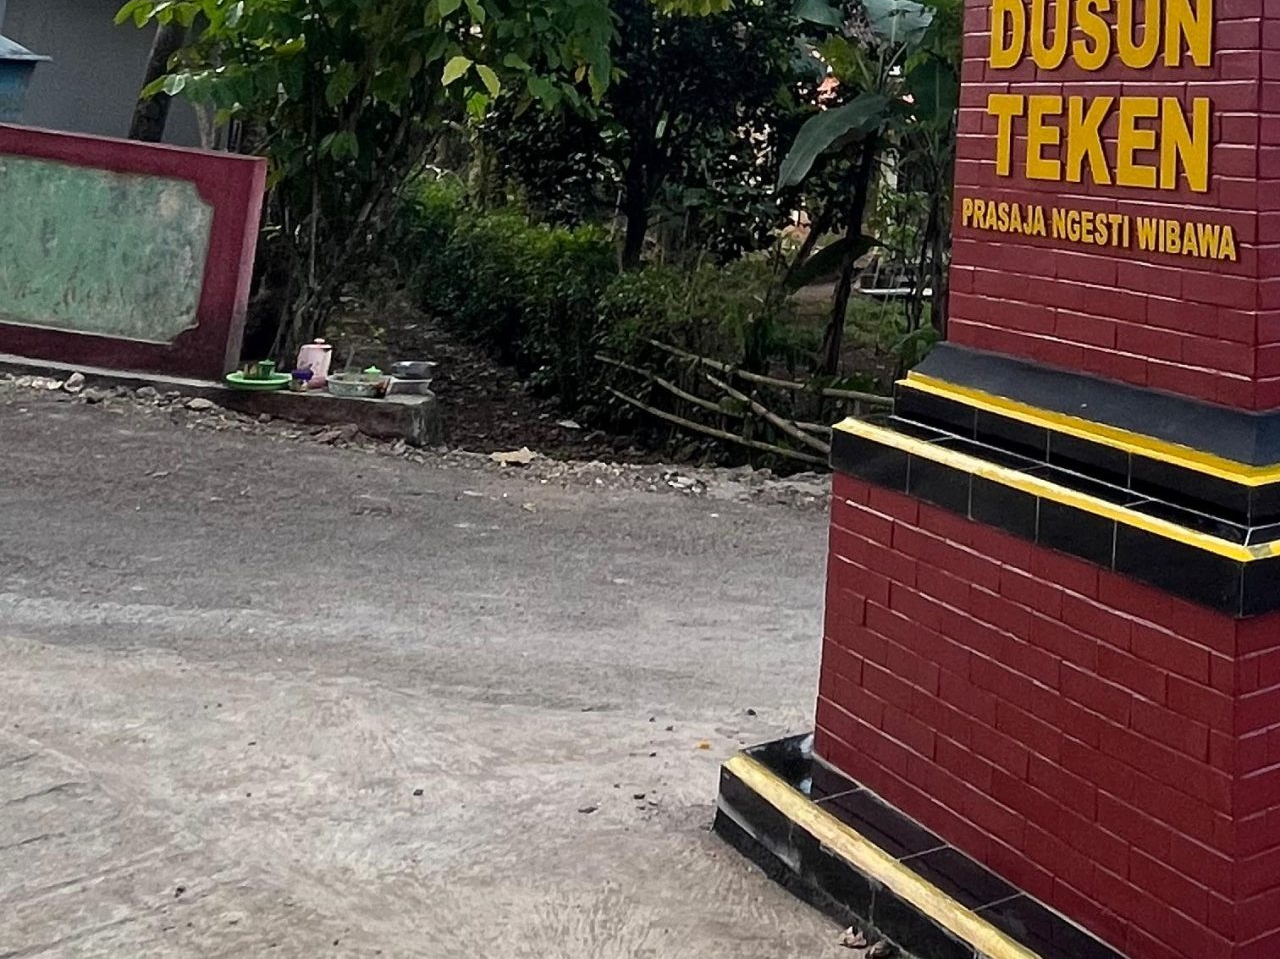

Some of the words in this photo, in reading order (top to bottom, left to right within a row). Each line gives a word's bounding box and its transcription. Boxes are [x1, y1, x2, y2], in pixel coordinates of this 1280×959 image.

[987, 94, 1211, 192] TEKEN
[962, 198, 1047, 237] PRASAJA
[1052, 208, 1130, 248] NGESTI
[1137, 217, 1237, 261] WIBAWA
